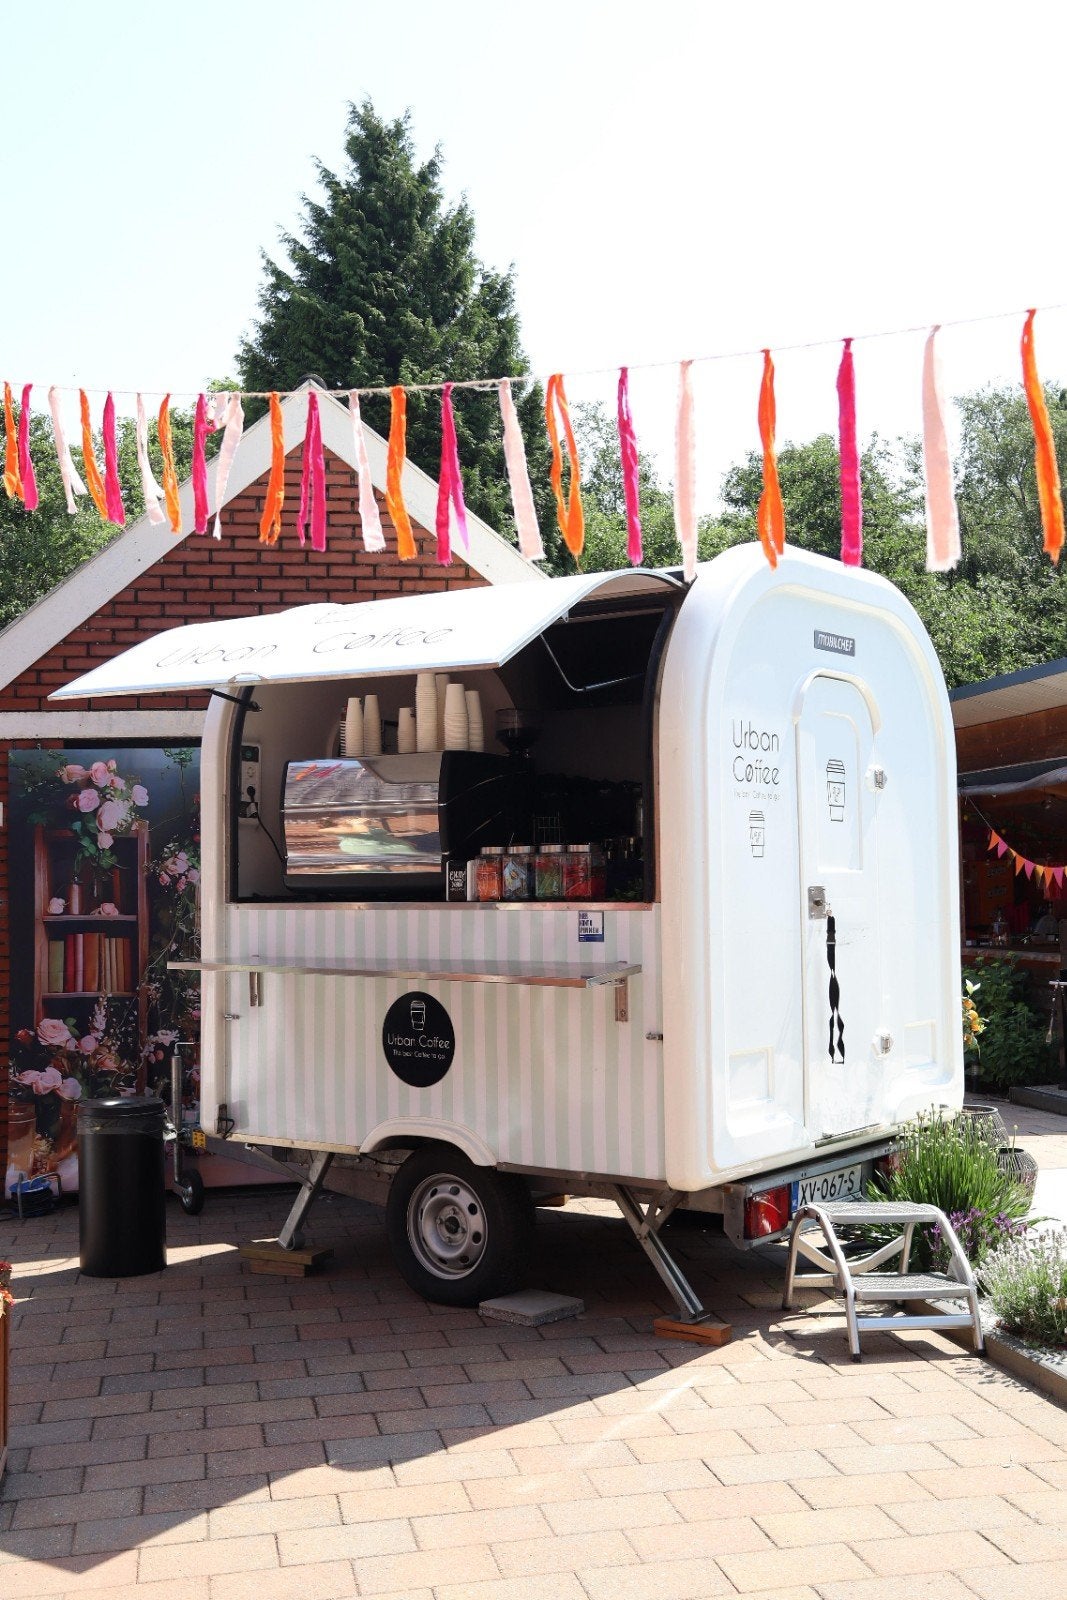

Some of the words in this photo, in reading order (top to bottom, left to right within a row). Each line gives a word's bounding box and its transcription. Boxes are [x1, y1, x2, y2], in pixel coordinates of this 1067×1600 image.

[156, 643, 277, 667] Urban
[313, 626, 453, 653] Coffee
[732, 719, 780, 752] Urban
[732, 755, 780, 785] Coffee
[387, 1033, 416, 1047] Urban
[418, 1034, 450, 1049] Coffee
[800, 1170, 855, 1206] XV-067-S
